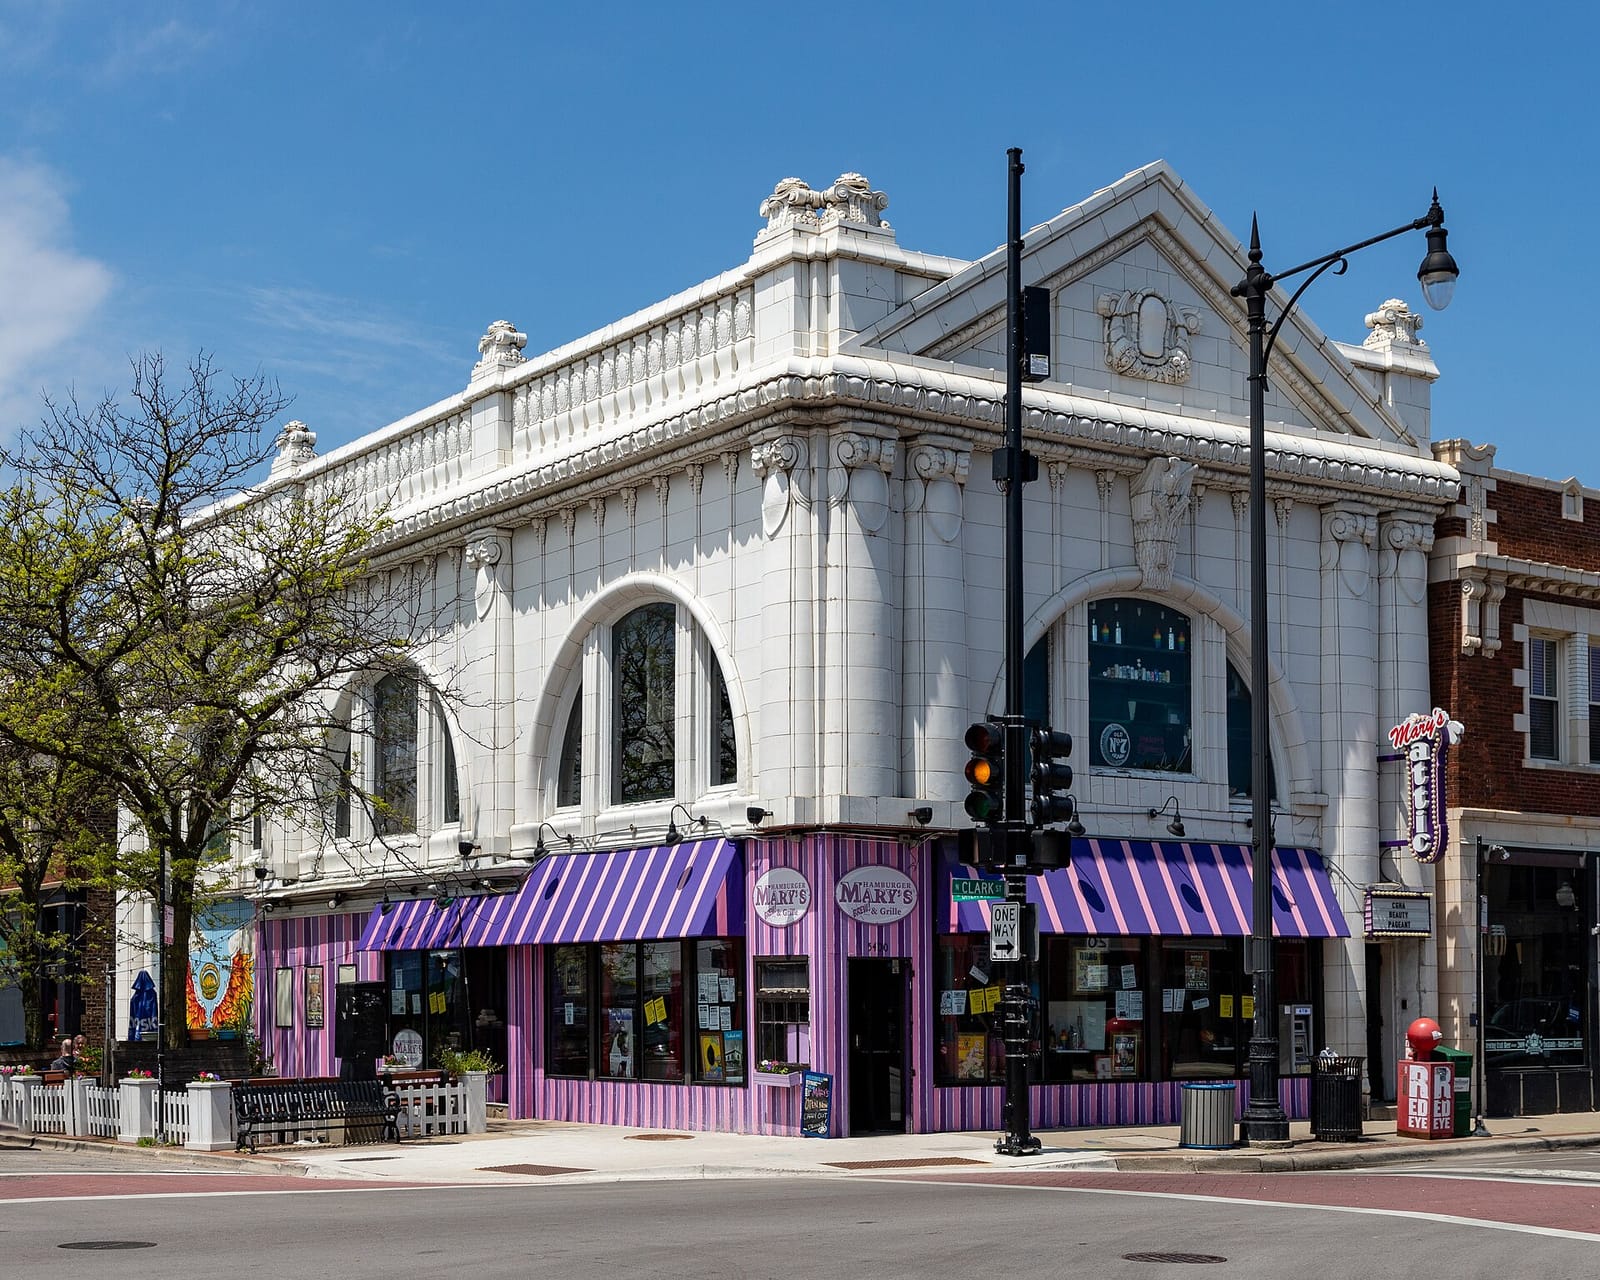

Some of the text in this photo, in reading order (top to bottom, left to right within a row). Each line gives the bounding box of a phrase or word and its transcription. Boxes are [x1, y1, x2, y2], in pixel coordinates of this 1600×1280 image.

[1390, 710, 1445, 747] Mary's
[1410, 742, 1432, 852] attic
[839, 881, 913, 904] MARY'S
[863, 881, 911, 889] HAMBURGER
[962, 881, 994, 894] CLARK
[756, 885, 807, 906] MARY'S
[871, 907, 878, 915] &
[880, 907, 902, 915] Grille
[994, 908, 1015, 921] ONE
[1388, 911, 1408, 919] BEAUTY
[993, 923, 1016, 937] WAY
[1409, 1065, 1429, 1099] R
[1433, 1066, 1451, 1099] R
[1409, 1098, 1429, 1117] ED
[1433, 1099, 1451, 1117] ED
[1408, 1116, 1428, 1129] EYE
[1433, 1117, 1450, 1130] EYE
